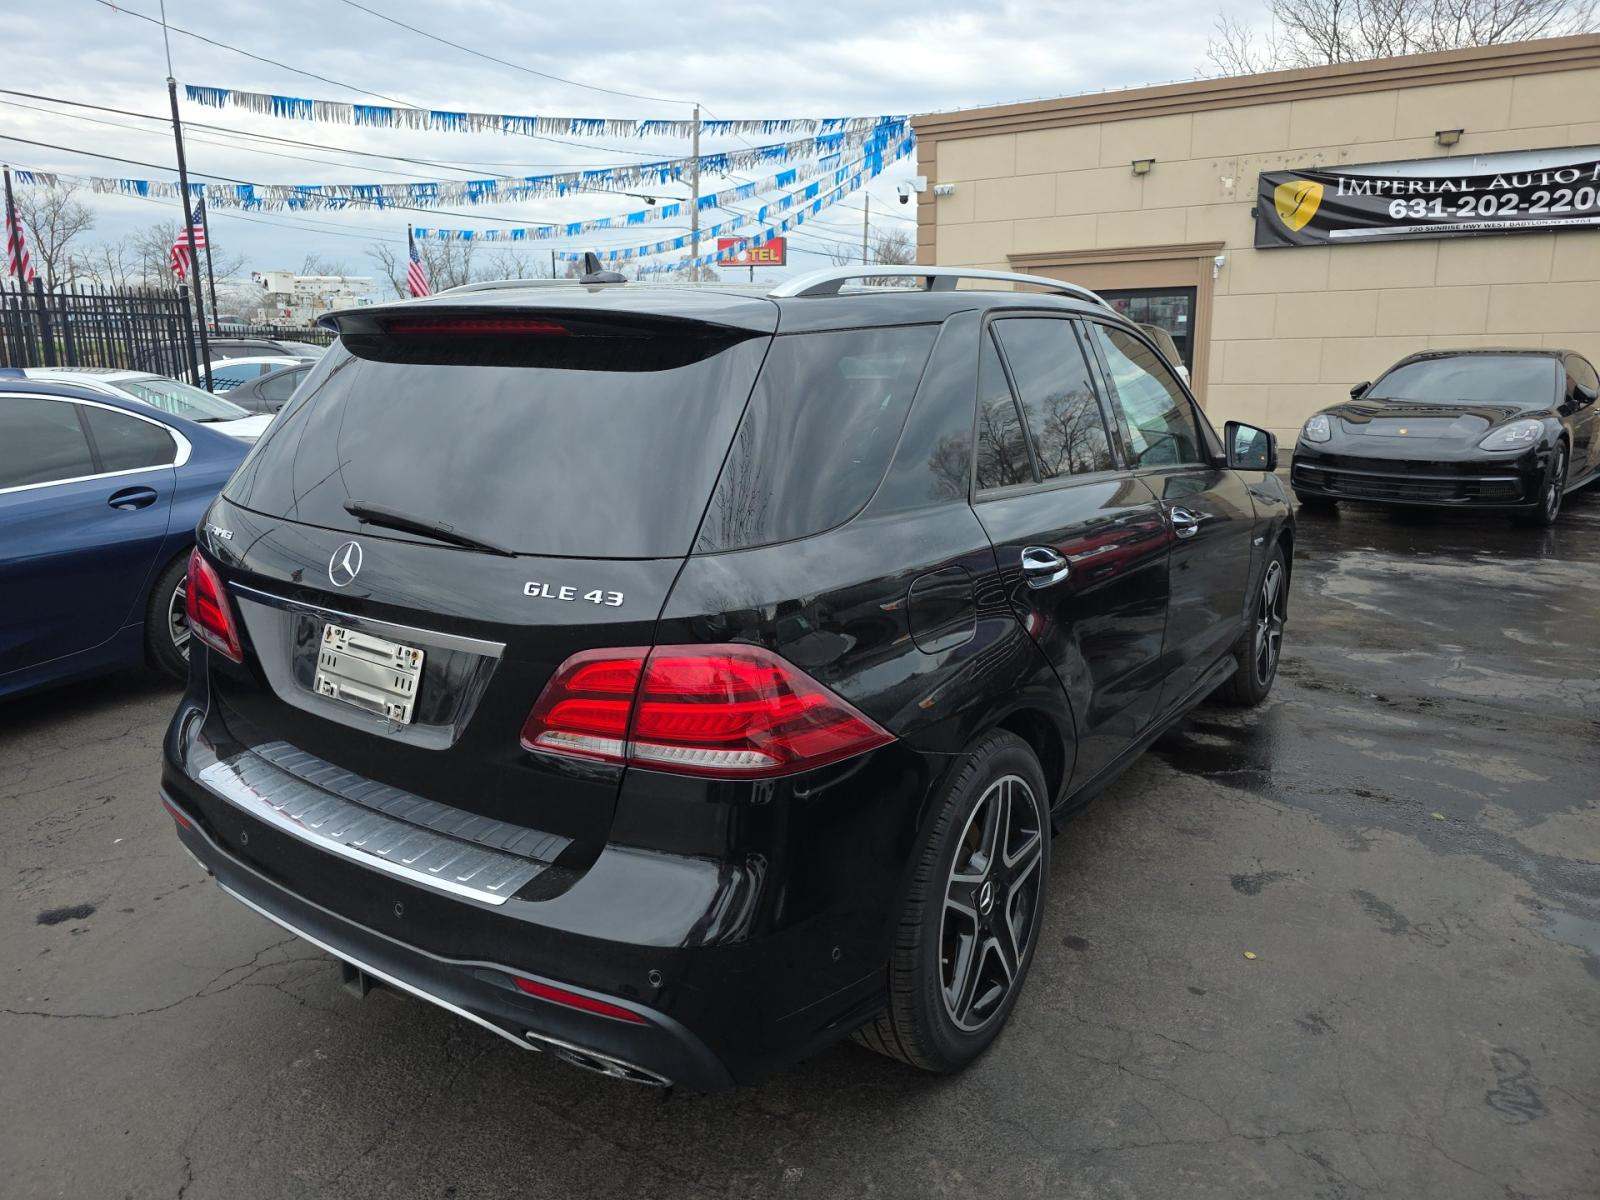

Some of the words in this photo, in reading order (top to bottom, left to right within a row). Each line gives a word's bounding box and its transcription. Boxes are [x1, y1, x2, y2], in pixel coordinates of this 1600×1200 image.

[1336, 177, 1475, 197] IMPERIAL
[1486, 168, 1580, 190] AUTO
[1388, 187, 1600, 219] 631-202-220
[1424, 224, 1461, 232] SUNRISE
[1484, 221, 1506, 229] WEST
[523, 581, 578, 601] GLE
[583, 589, 624, 607] 43
